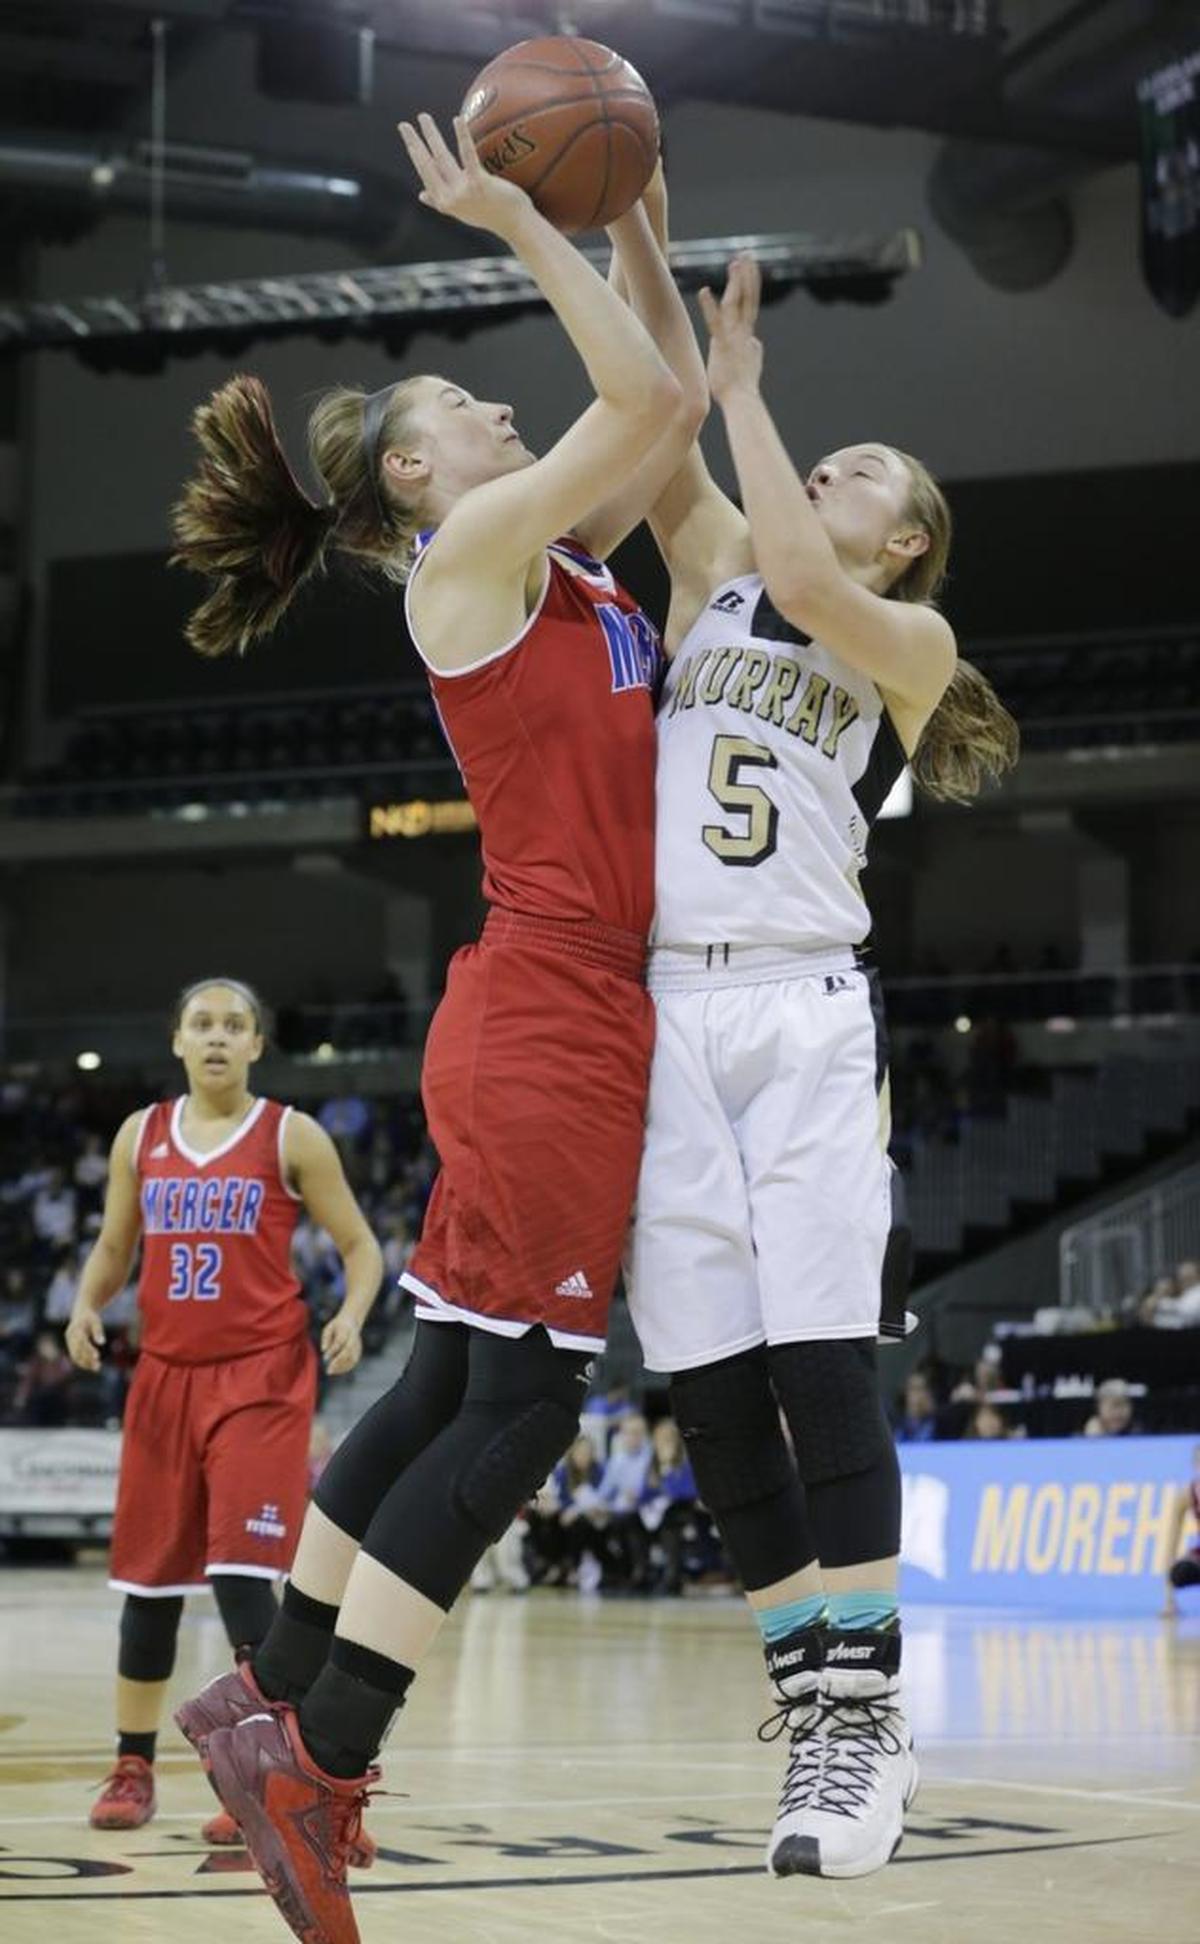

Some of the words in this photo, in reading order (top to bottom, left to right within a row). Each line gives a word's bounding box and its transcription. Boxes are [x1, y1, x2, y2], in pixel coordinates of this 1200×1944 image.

[669, 648, 859, 760] MURRAY
[702, 734, 779, 867] 5
[140, 1177, 265, 1236] MERCER
[167, 1243, 223, 1301] 32
